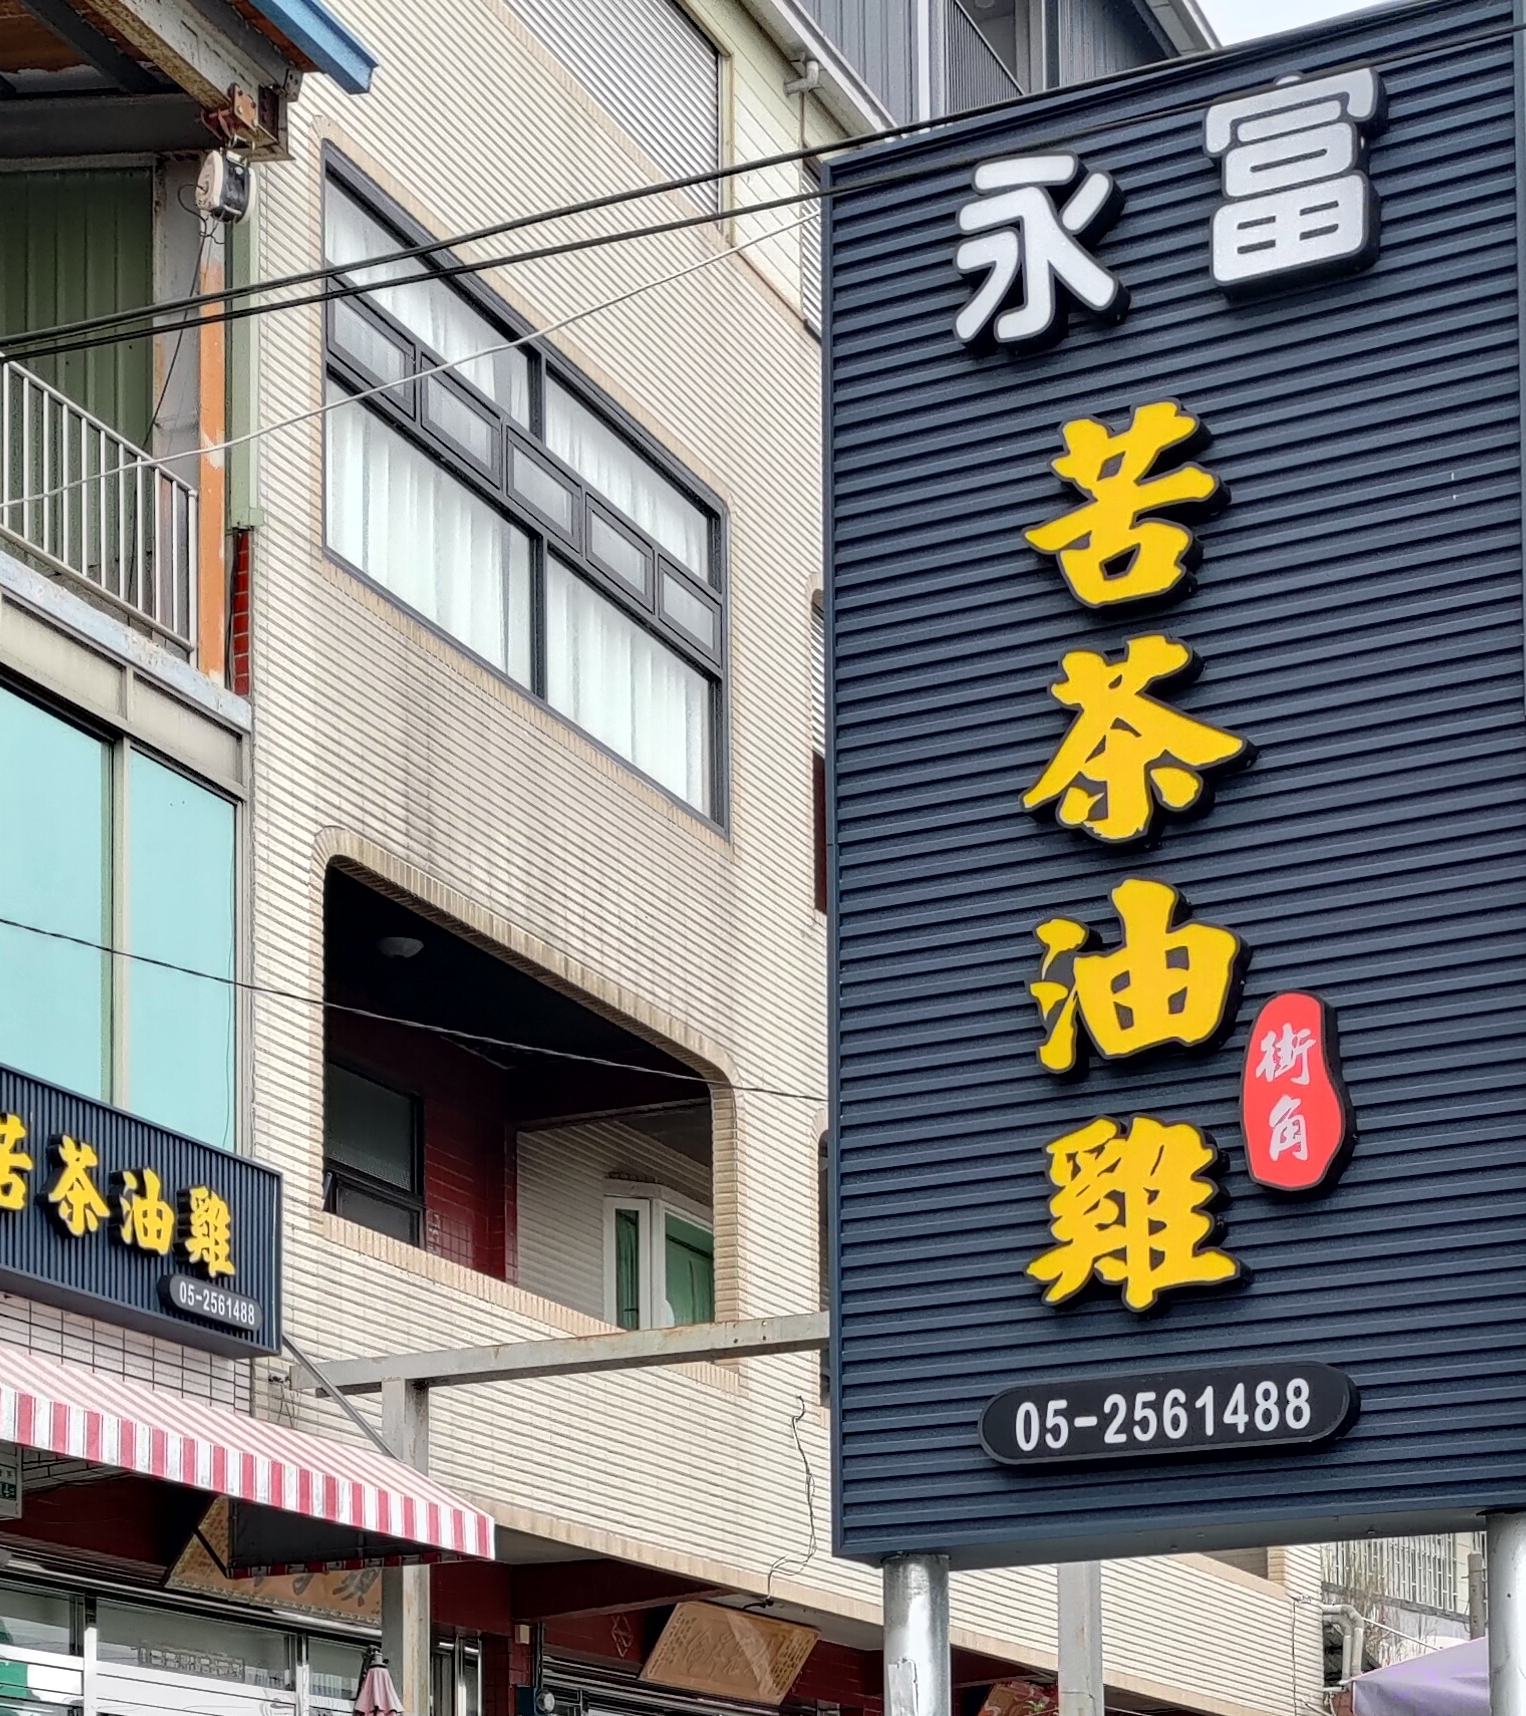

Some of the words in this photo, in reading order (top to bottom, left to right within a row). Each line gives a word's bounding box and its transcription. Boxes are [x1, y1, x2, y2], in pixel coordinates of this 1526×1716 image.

[954, 66, 1381, 344] 永富
[1021, 400, 1247, 1312] 苦茶油雞
[1255, 1024, 1316, 1163] 街角
[178, 1280, 256, 1327] 05-2561488
[1014, 1377, 1312, 1453] 05-2561488
